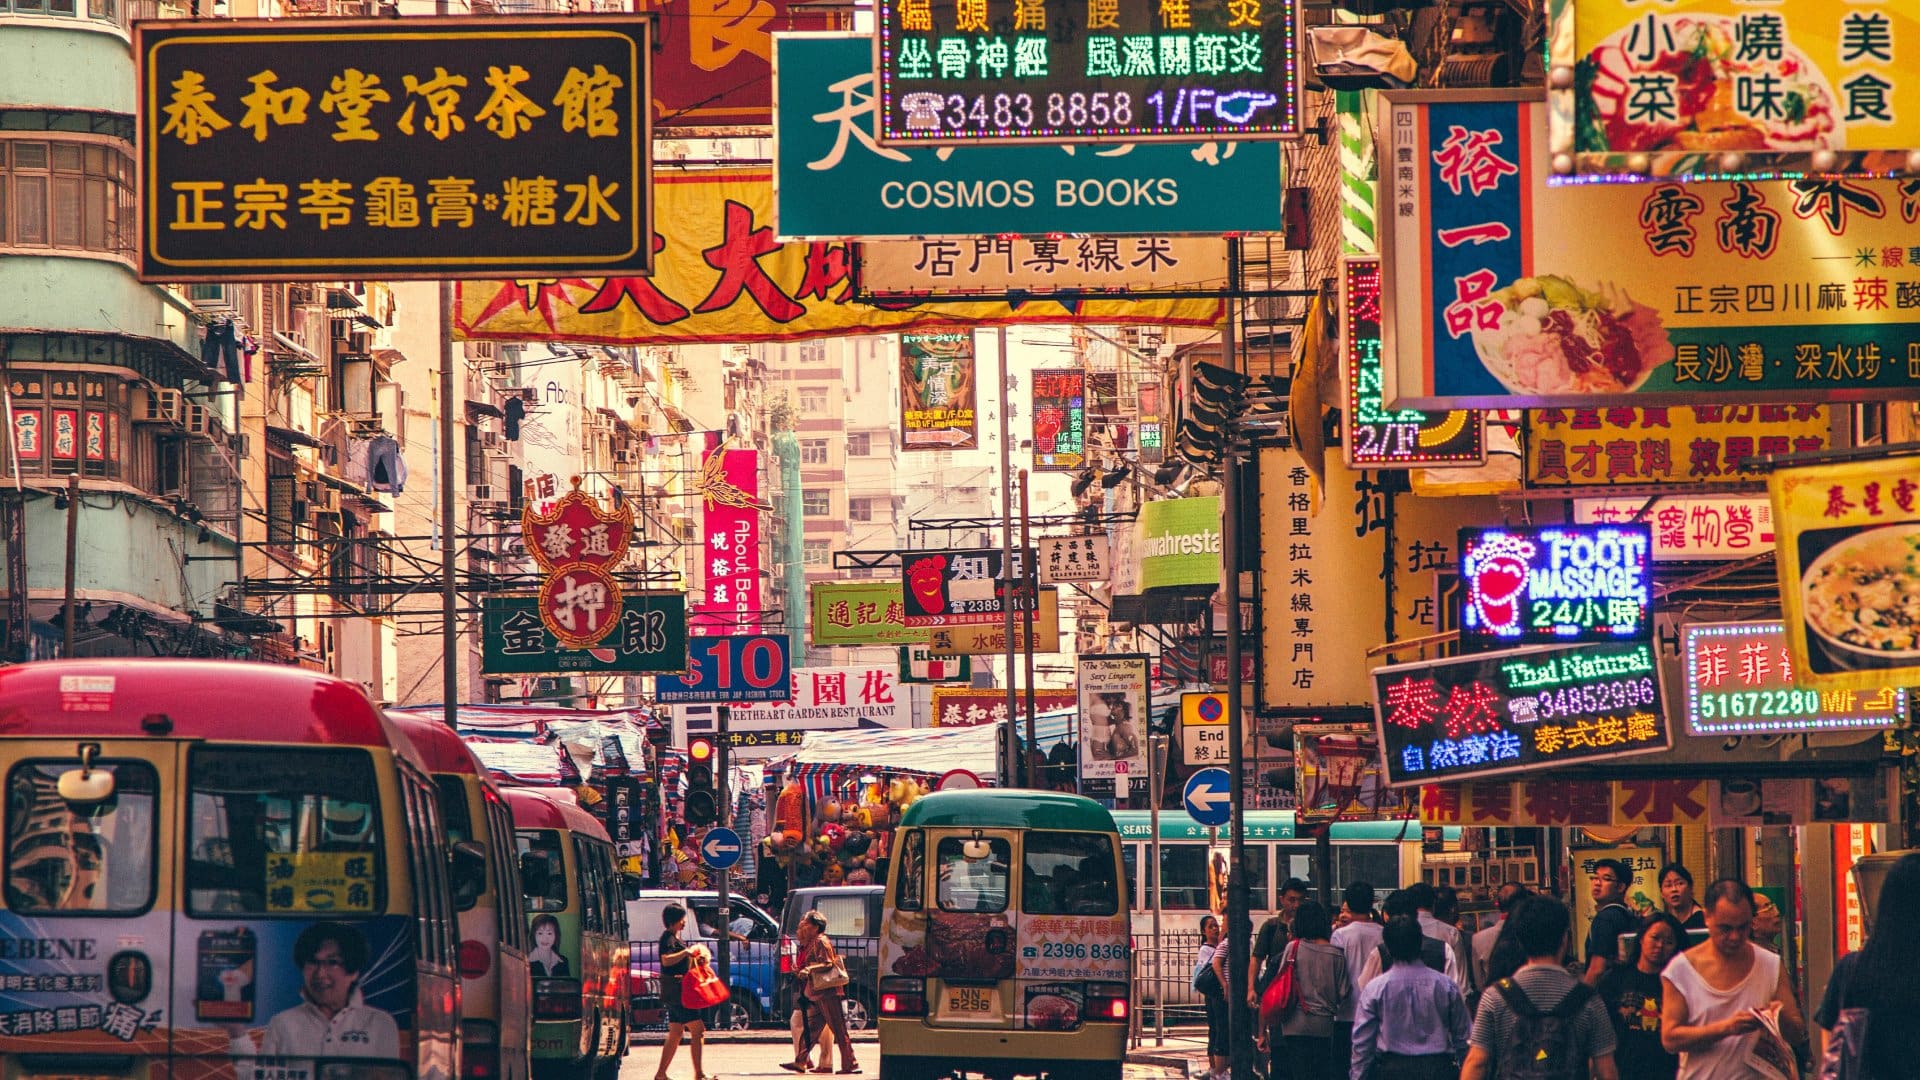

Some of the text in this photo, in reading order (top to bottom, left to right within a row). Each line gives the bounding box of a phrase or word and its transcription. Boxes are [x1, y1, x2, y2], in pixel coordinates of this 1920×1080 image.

[897, 37, 1048, 79] 坐骨神經
[946, 88, 1216, 128] 3483 8858 1/F
[880, 177, 1179, 209] COSMOS BOOKS
[1433, 126, 1517, 339] 裕一品
[1356, 423, 1419, 456] 2/F
[734, 519, 751, 574] About
[1551, 535, 1646, 570] FOOT
[1528, 566, 1643, 600] MASSAGE
[552, 574, 607, 632] 押
[1532, 598, 1641, 628] 24小時
[501, 610, 667, 664] 金郎
[787, 707, 830, 720] GARDEN
[831, 705, 896, 719] RESTAURANT
[1539, 677, 1655, 719] 34852996
[1700, 689, 1819, 719] 51672280
[1199, 730, 1224, 741] End
[1194, 745, 1230, 761] 終止
[1123, 824, 1153, 836] SEATS
[1043, 942, 1086, 959] 2396
[950, 998, 990, 1011] 5296
